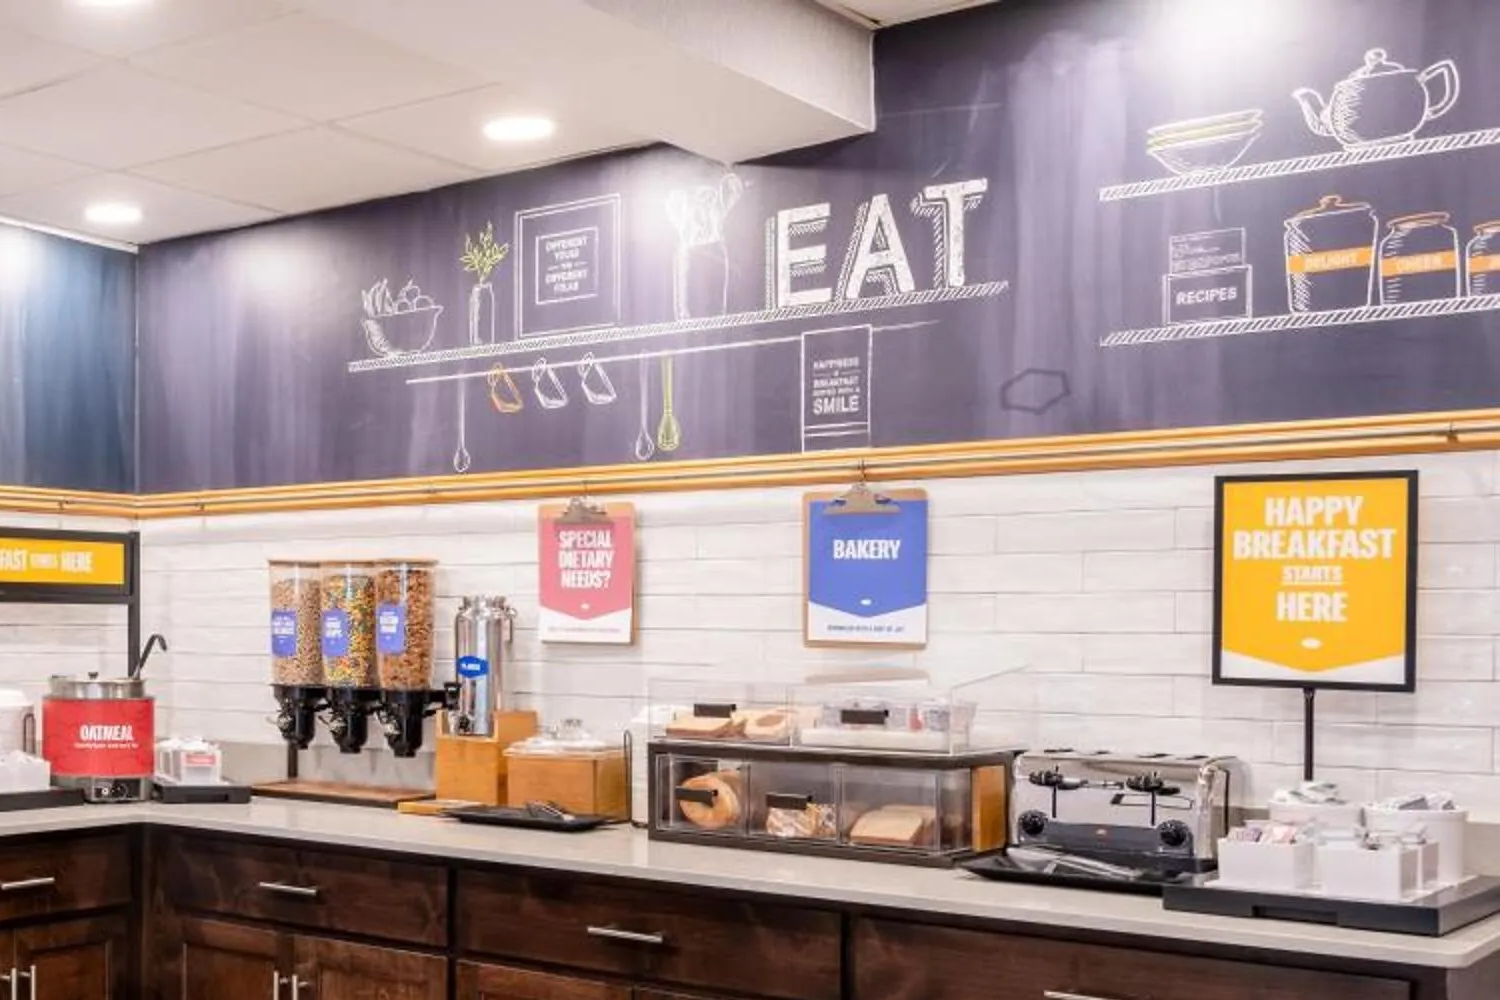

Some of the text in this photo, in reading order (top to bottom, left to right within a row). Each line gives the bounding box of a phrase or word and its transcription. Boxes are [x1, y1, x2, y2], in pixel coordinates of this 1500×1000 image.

[765, 177, 988, 311] EAT
[1176, 286, 1238, 305] RECIPES
[813, 395, 860, 415] SMILE
[1264, 496, 1364, 527] HAPPY
[558, 530, 612, 549] SPECIAL
[832, 538, 901, 560] BAKERY
[1233, 528, 1396, 560] BREAKFAST
[60, 551, 93, 573] HERE
[558, 550, 615, 568] DIETARY
[561, 569, 611, 589] NEEDS?
[1282, 565, 1343, 585] STARTS
[1276, 592, 1348, 622] HERE
[80, 724, 134, 741] OATMEAL
